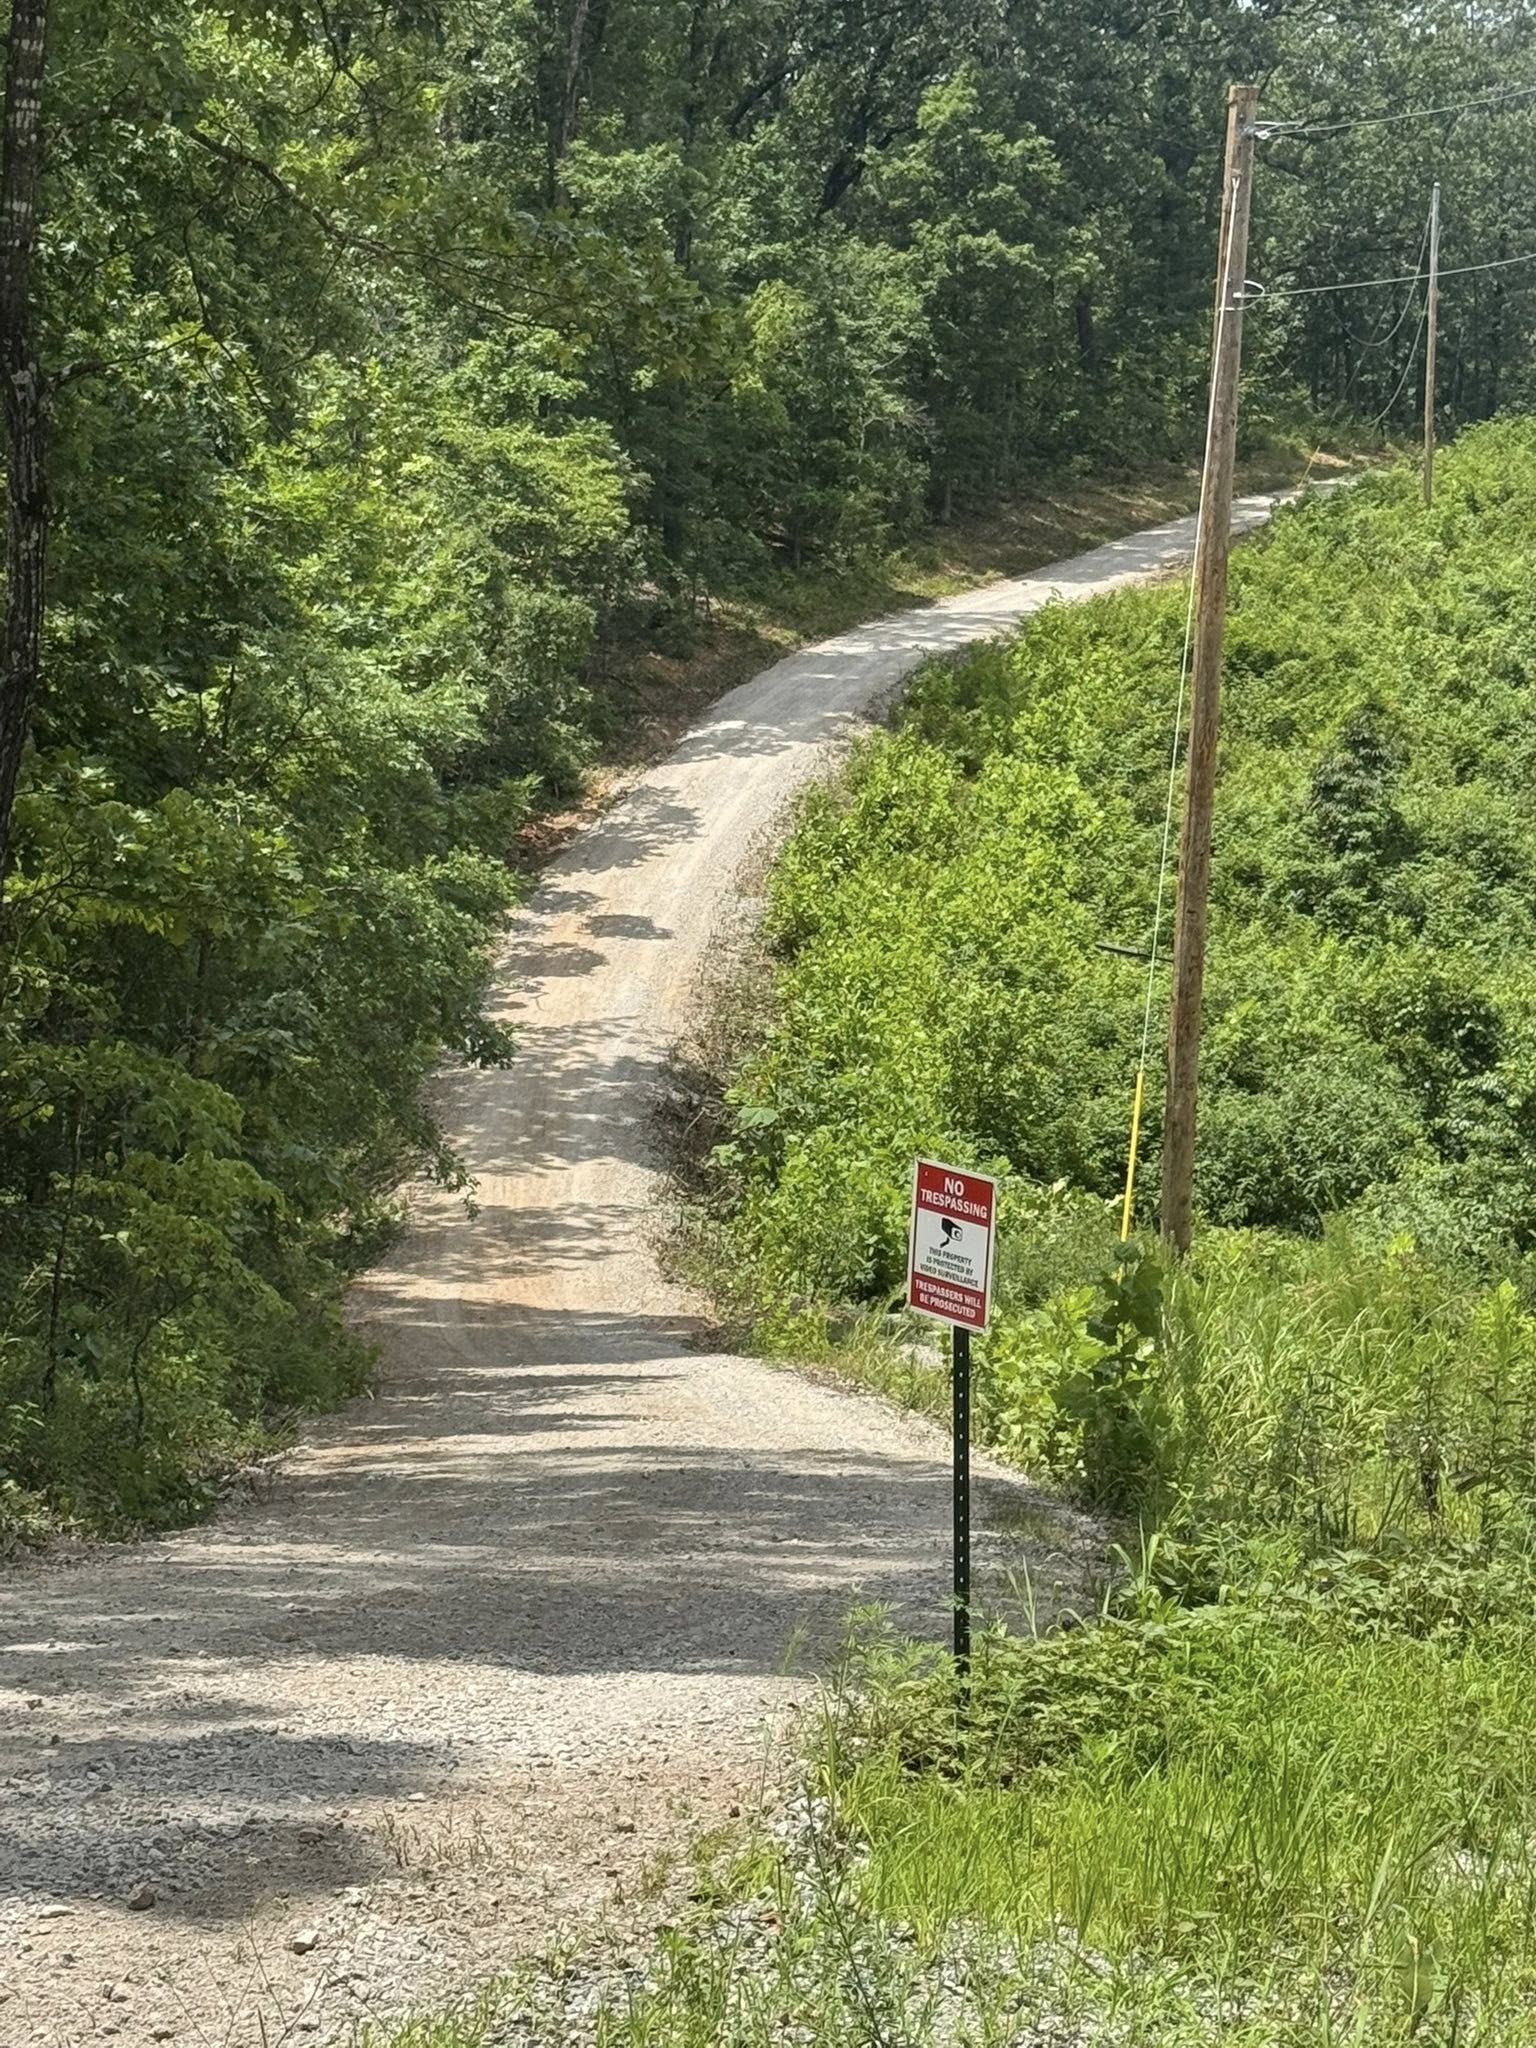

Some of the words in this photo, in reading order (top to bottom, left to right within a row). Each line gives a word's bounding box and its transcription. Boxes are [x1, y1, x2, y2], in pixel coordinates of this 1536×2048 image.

[944, 1177, 965, 1197] NO
[920, 1188, 988, 1219] TRESPASSING
[926, 1255, 932, 1263] IS
[933, 1257, 965, 1273] PROTECTED
[965, 1266, 974, 1276] BY
[929, 1246, 941, 1256] THIS
[942, 1250, 972, 1266] PROPERTY
[920, 1262, 937, 1275] VIDEO
[937, 1268, 979, 1288] SURVEILLANCE
[915, 1279, 964, 1302] TRESPASSERS
[964, 1294, 982, 1309] WILL
[919, 1292, 929, 1304] BE
[929, 1296, 976, 1319] PROSECUTED
